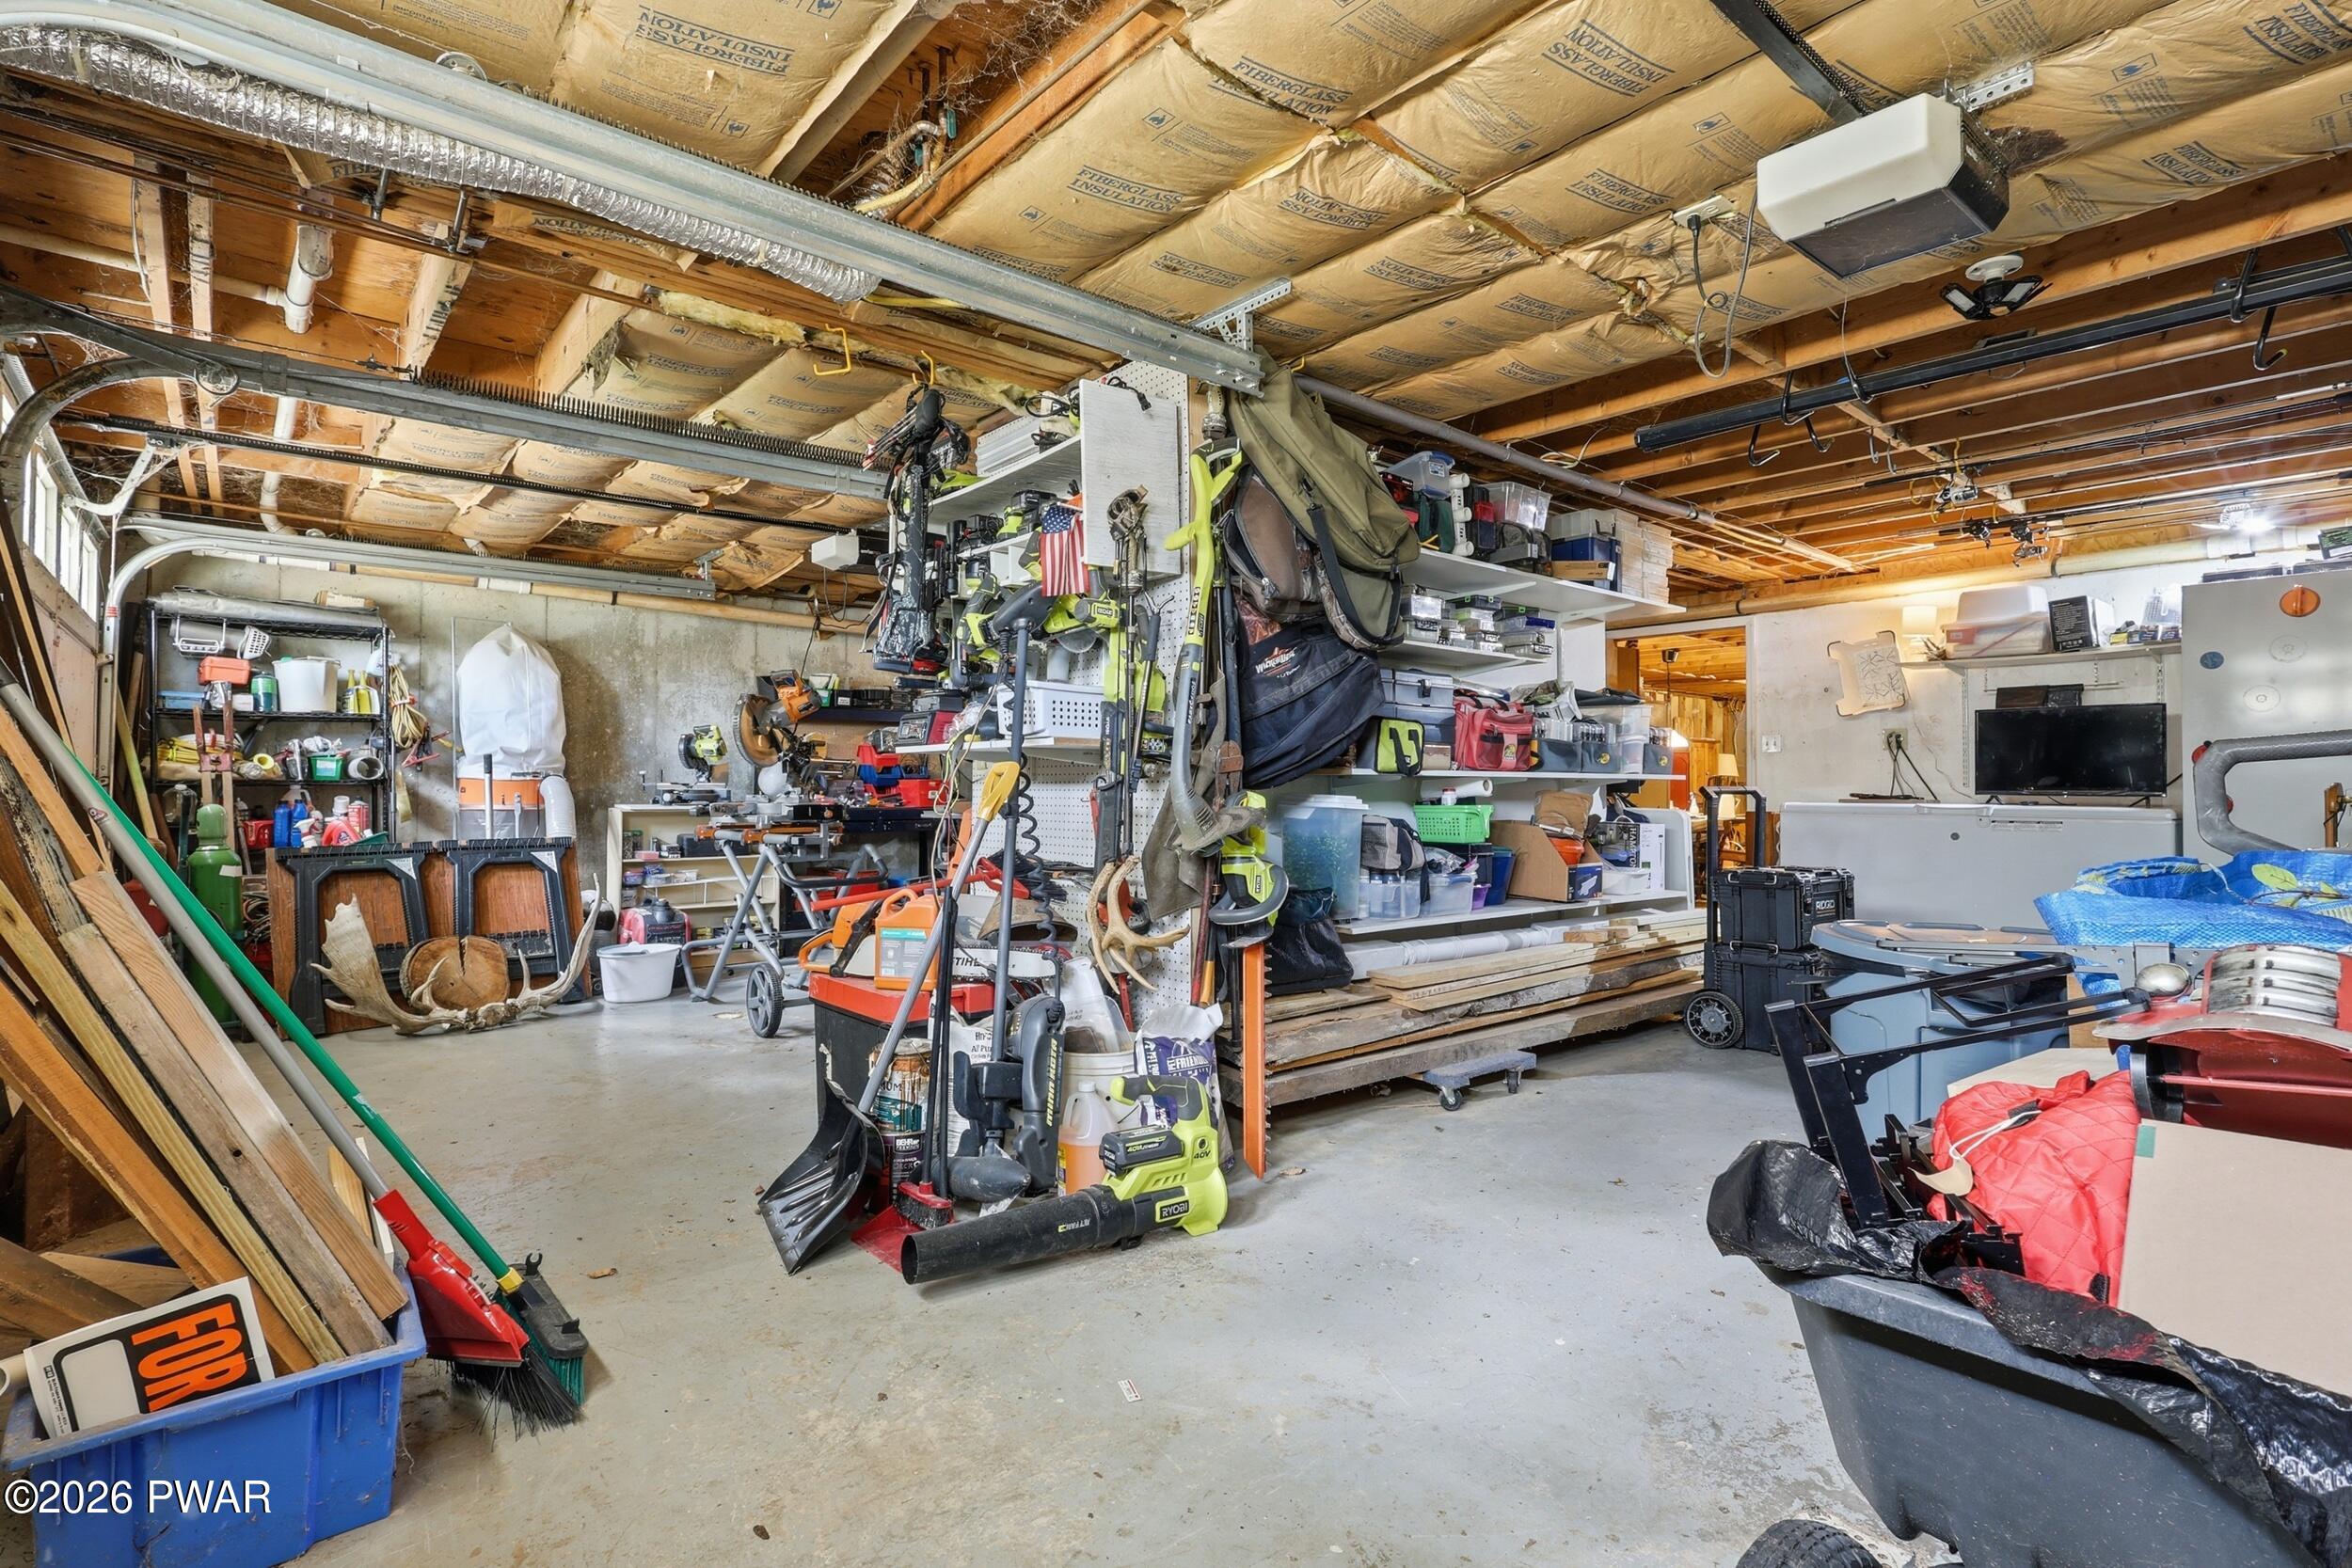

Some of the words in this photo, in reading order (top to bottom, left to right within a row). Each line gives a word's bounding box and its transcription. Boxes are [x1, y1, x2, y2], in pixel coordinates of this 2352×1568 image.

[1548, 41, 1651, 93] FIBERGLASS
[1565, 27, 1668, 83] INSULATION
[1232, 60, 1349, 103] FIBERGLASS
[1072, 179, 1174, 212] INSULATION
[1077, 168, 1184, 204] FIBERGLASS
[952, 957, 981, 967] TIHL
[1193, 1149, 1211, 1160] 40V
[1162, 1201, 1188, 1217] RYOBI
[132, 1302, 247, 1412] FOR
